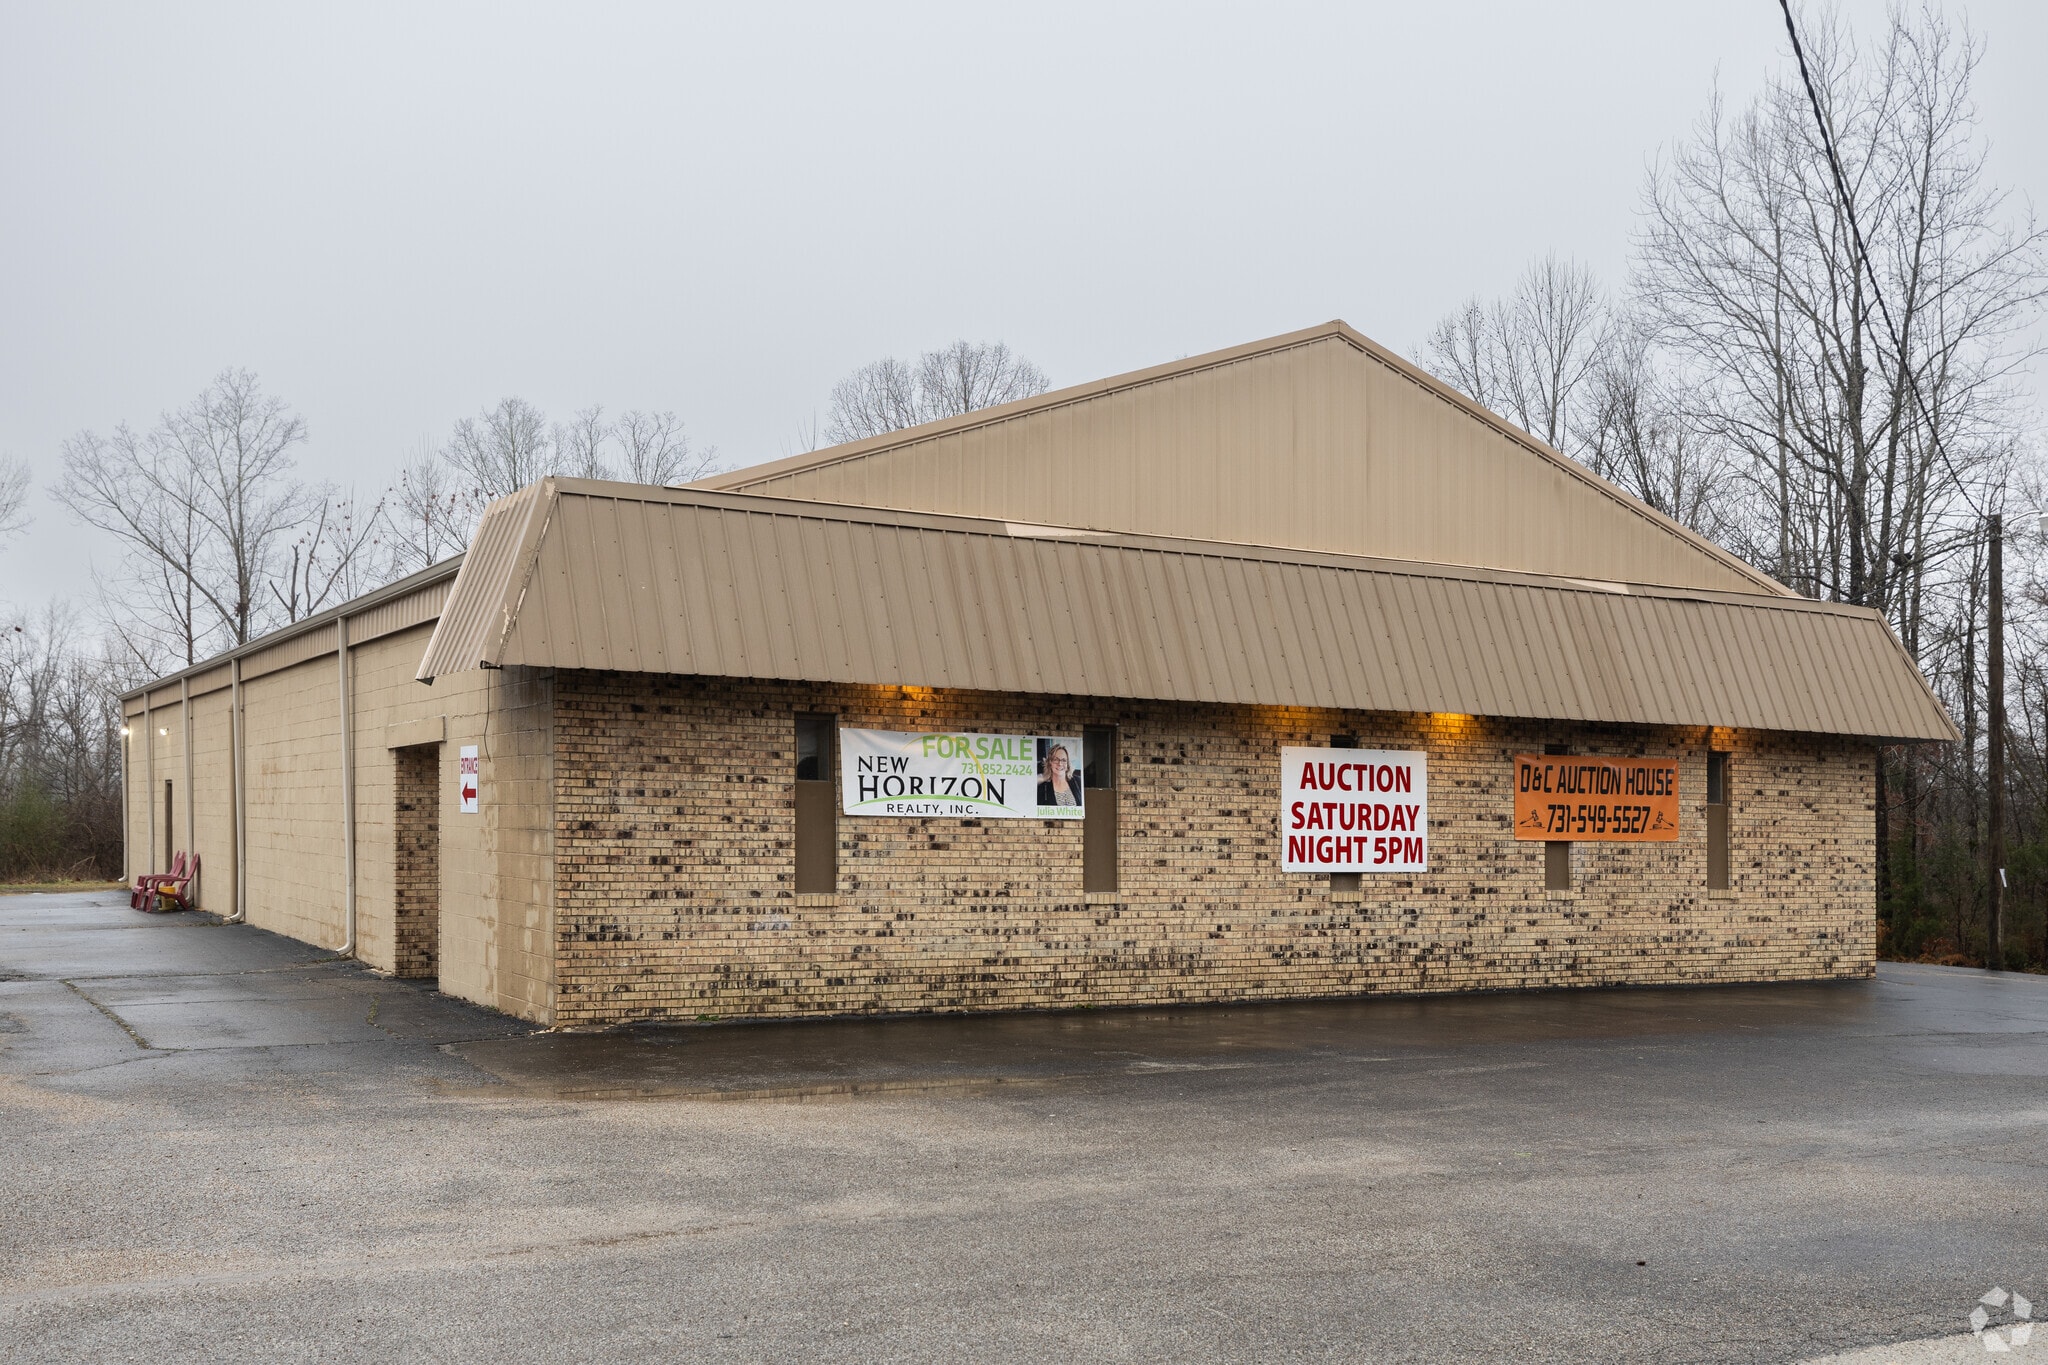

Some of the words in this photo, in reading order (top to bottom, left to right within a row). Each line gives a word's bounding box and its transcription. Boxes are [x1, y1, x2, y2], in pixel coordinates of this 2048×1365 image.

[922, 735, 970, 760] FOR
[976, 737, 1033, 761] SALE
[858, 755, 909, 774] NEW
[961, 763, 1033, 776] 731.852.2424
[1300, 762, 1411, 793] AUCTION
[858, 775, 1006, 805] HORIZON
[1520, 764, 1553, 793] D&C
[1556, 765, 1622, 795] AUCTION
[1626, 767, 1675, 796] HOUSE
[887, 803, 943, 815] REALTY,
[950, 804, 979, 815] INC.
[1037, 806, 1055, 817] Julia
[1056, 806, 1083, 817] White
[1291, 801, 1420, 832] SATURDAY
[1547, 804, 1651, 834] 731-549-5527
[1288, 835, 1368, 864] NIGHT
[1373, 836, 1423, 864] 5PM
